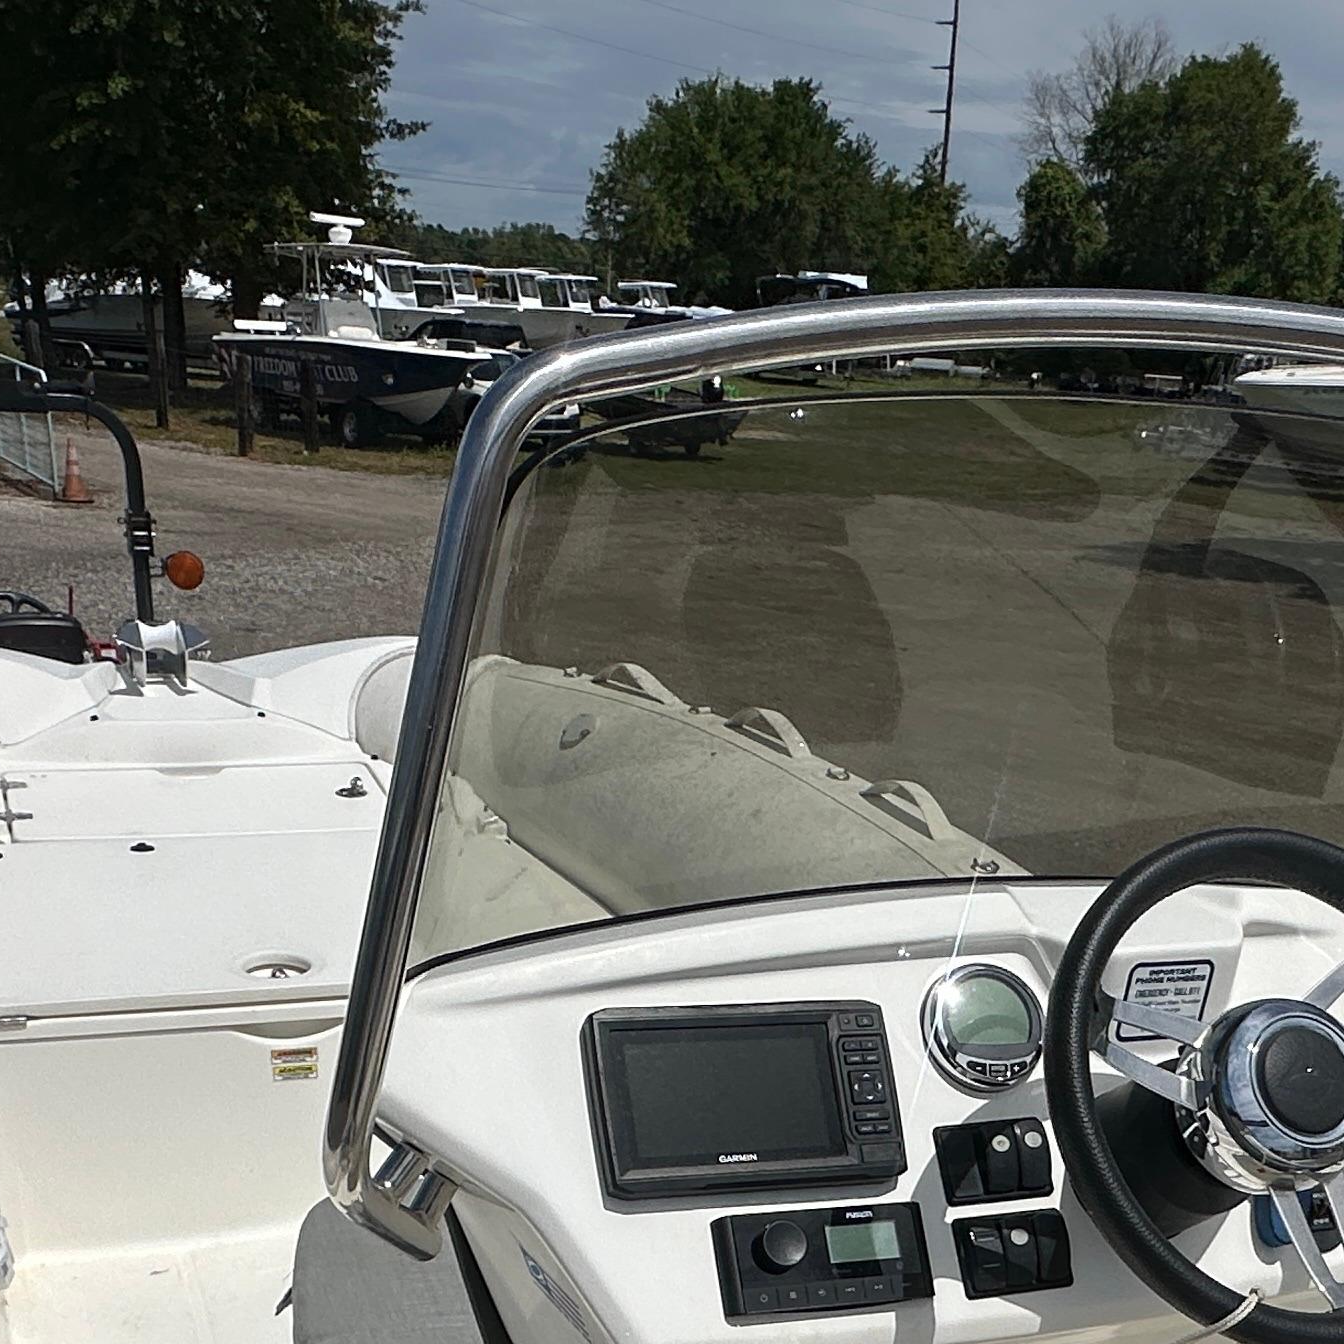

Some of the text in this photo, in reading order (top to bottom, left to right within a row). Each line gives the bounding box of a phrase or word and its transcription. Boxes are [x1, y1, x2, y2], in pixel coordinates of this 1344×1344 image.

[325, 366, 359, 383] CLUB
[1149, 968, 1197, 976] IMPORTANT
[718, 1153, 758, 1163] GARMIN
